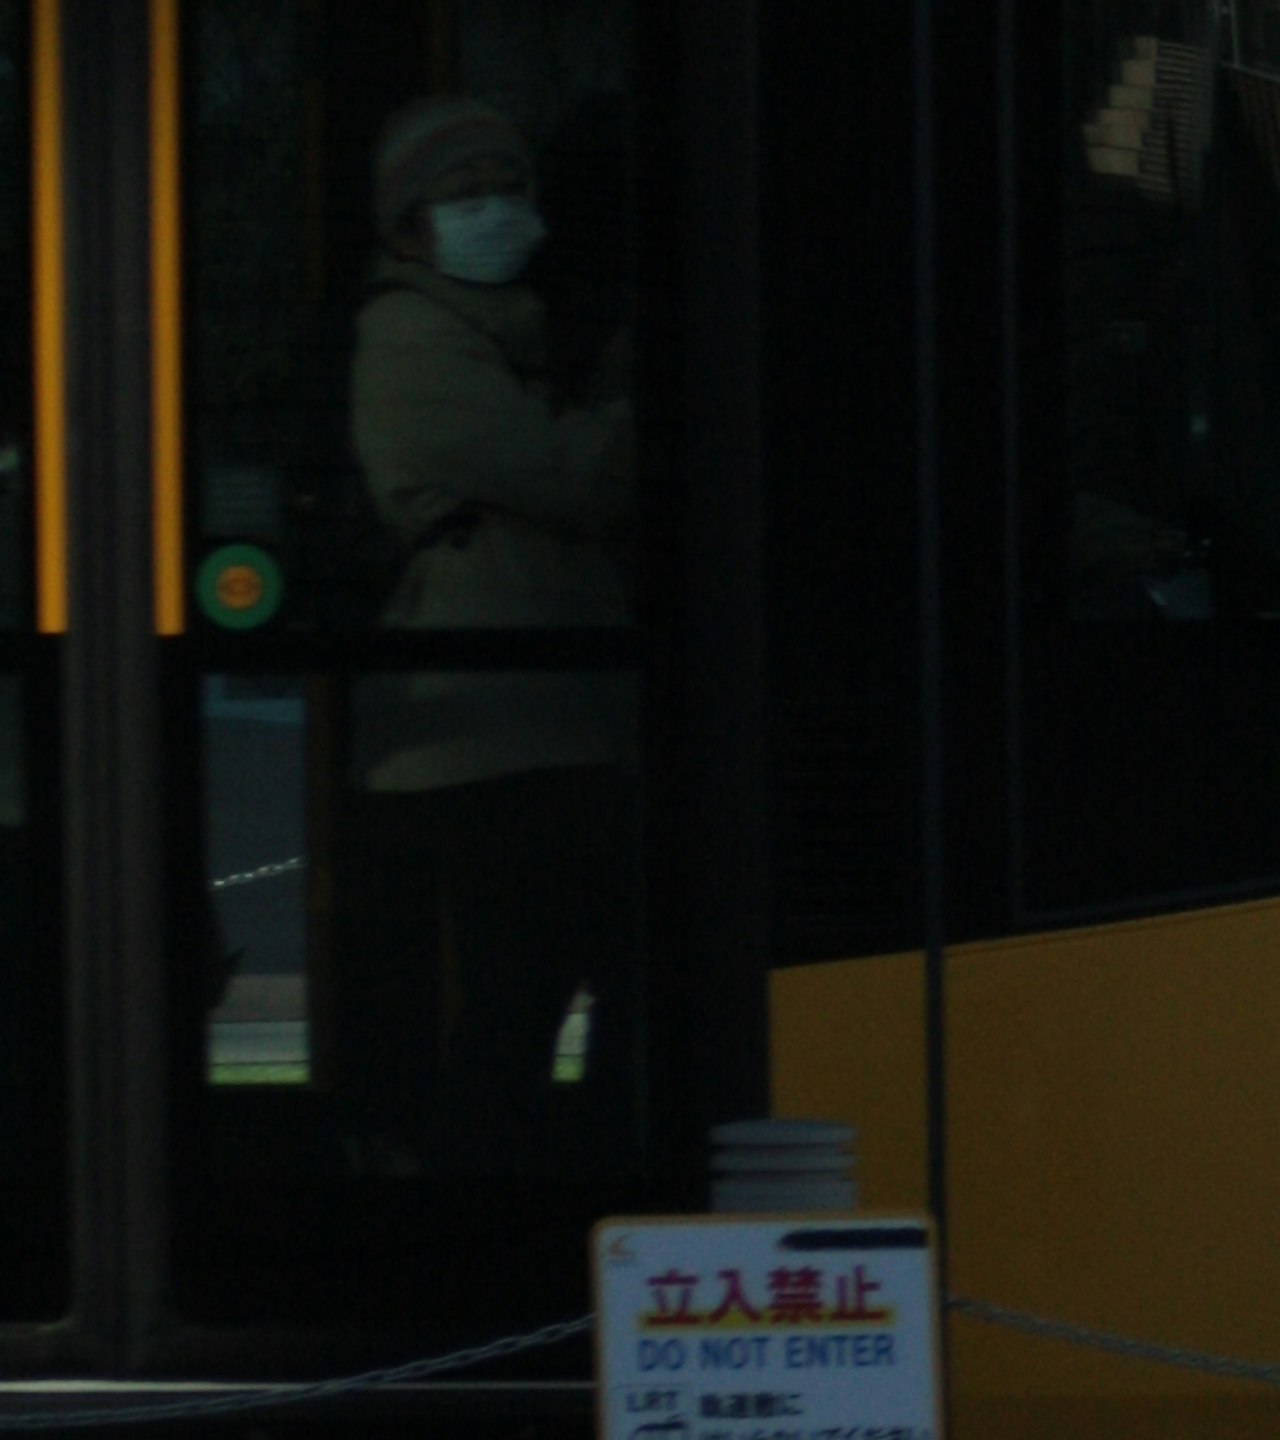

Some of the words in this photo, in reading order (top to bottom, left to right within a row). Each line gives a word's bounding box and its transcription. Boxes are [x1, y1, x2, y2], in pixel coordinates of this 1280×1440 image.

[646, 1265, 887, 1325] 立入禁止
[637, 1338, 686, 1371] DO
[702, 1336, 770, 1370] NOT
[785, 1334, 895, 1369] ENTER
[626, 1390, 678, 1413] LRT
